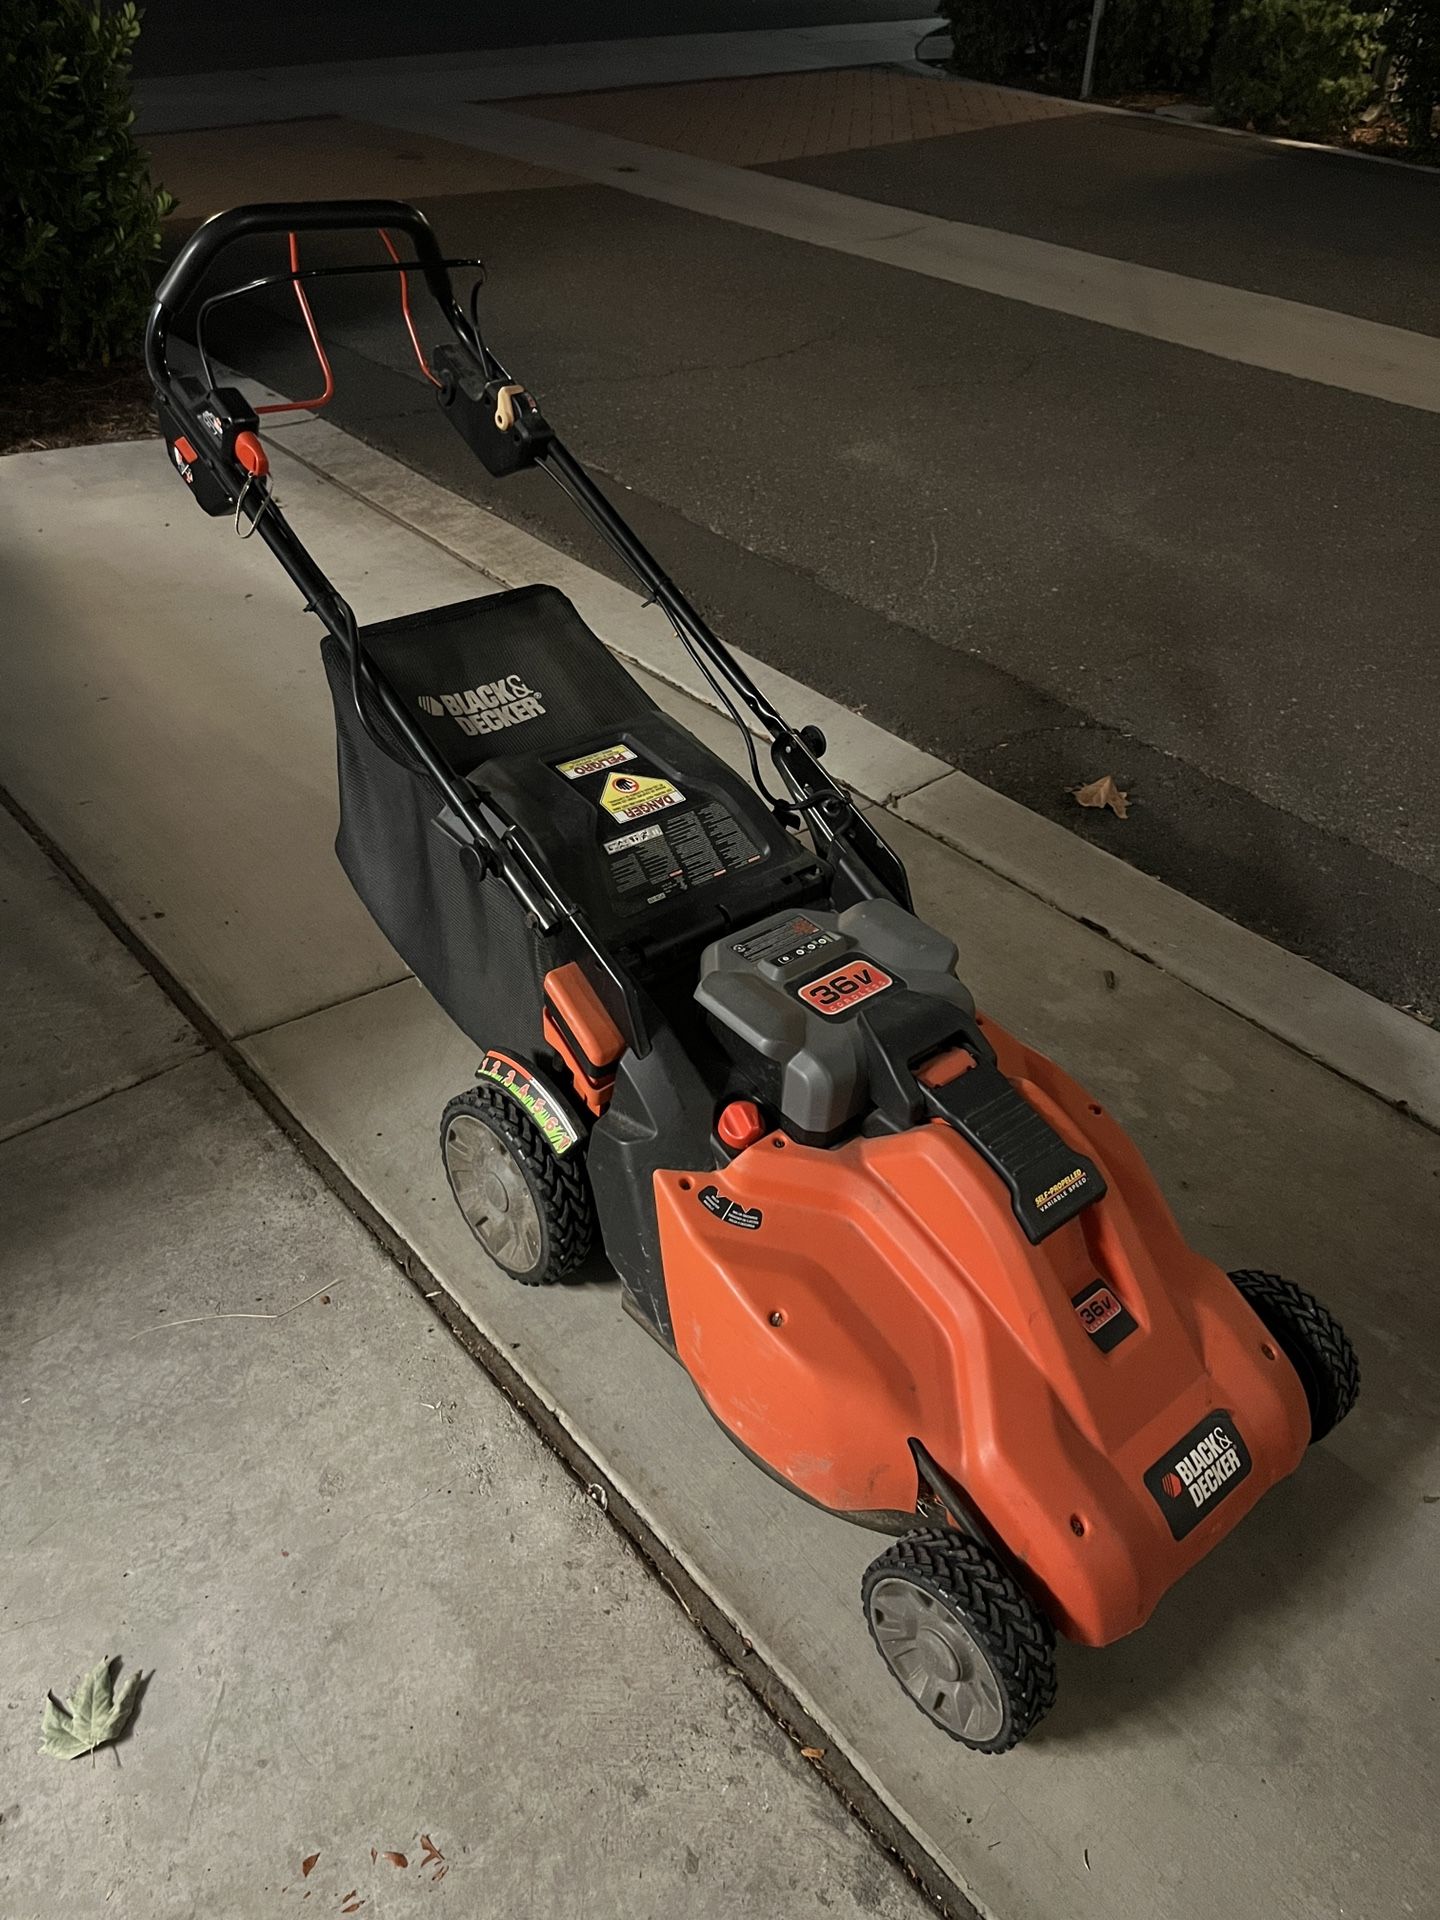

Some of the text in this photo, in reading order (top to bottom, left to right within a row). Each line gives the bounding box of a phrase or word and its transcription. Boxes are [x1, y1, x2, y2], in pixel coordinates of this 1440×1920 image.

[454, 696, 546, 736] DECKER
[574, 752, 627, 775] PELIGRO
[624, 794, 676, 818] DANGER
[829, 980, 887, 1012] CORDLESS
[545, 1116, 558, 1131] 6
[1039, 1177, 1088, 1213] VARIABLE SPEED
[1188, 1447, 1241, 1508] DECKER
